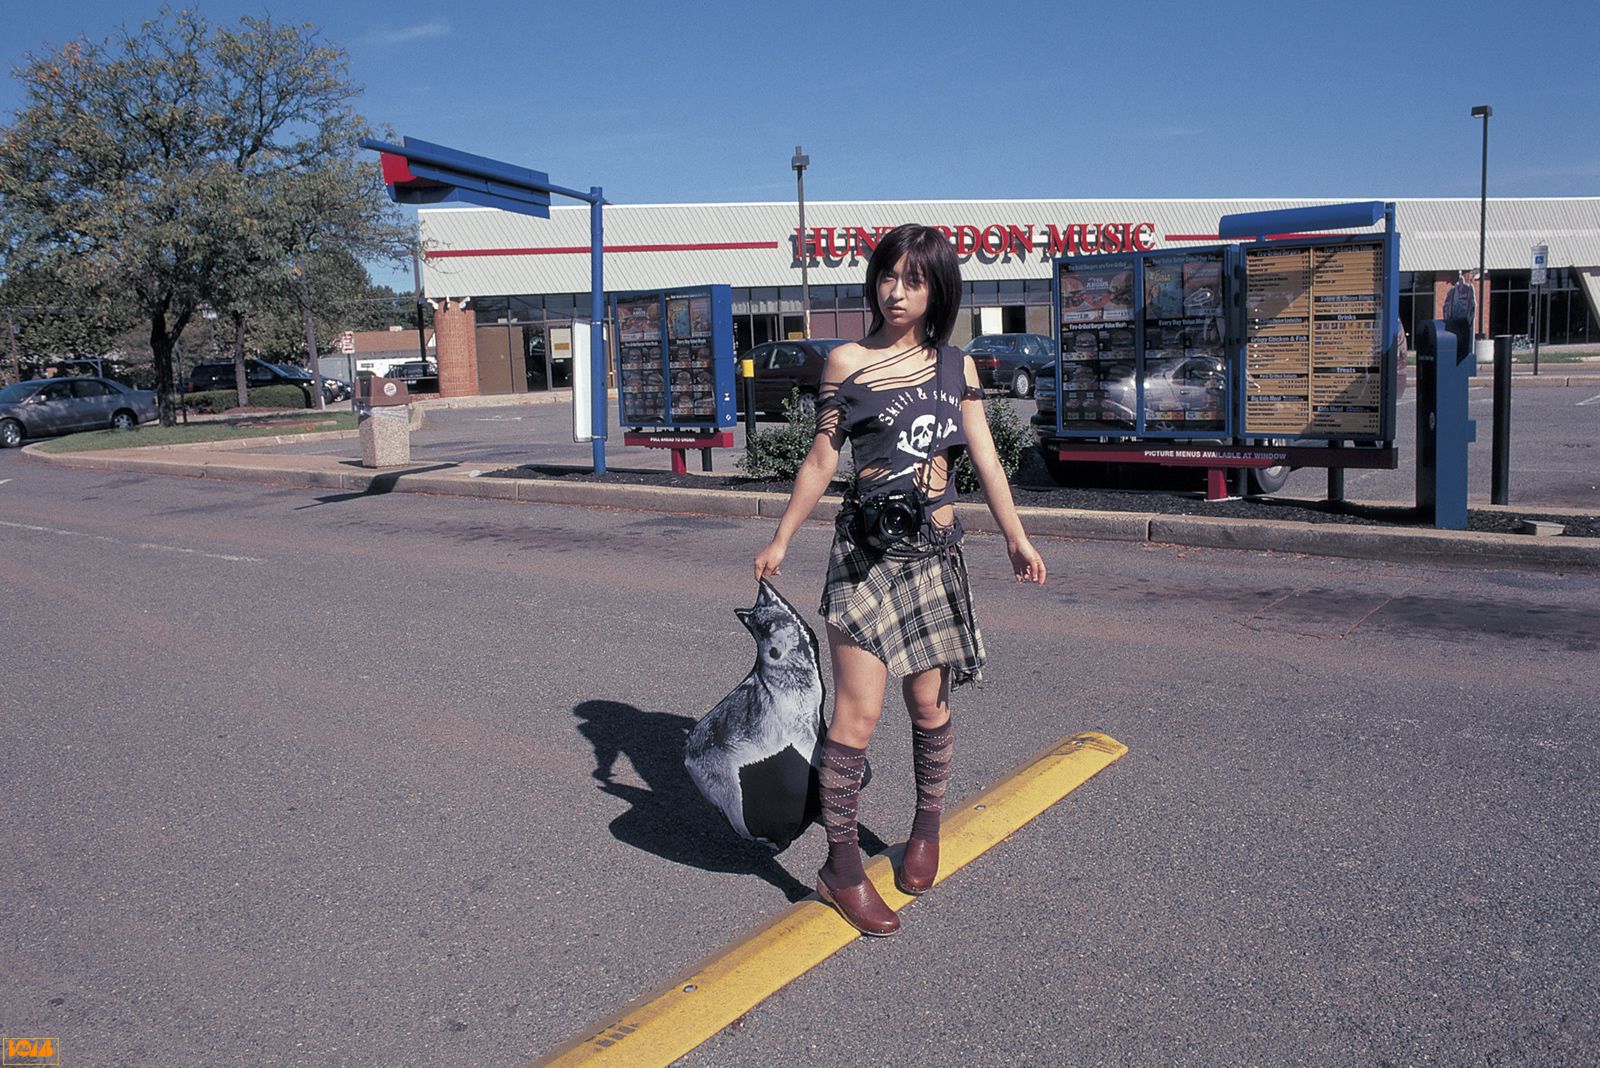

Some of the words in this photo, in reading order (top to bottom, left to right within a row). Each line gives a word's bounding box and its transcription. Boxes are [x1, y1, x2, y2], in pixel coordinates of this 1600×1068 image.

[793, 224, 1034, 257] HUNDON
[1046, 223, 1156, 255] MUSIC
[916, 387, 928, 400] &
[1175, 450, 1201, 458] MENUS
[1202, 451, 1241, 459] AVAILABLE
[1253, 452, 1287, 460] WINDOW
